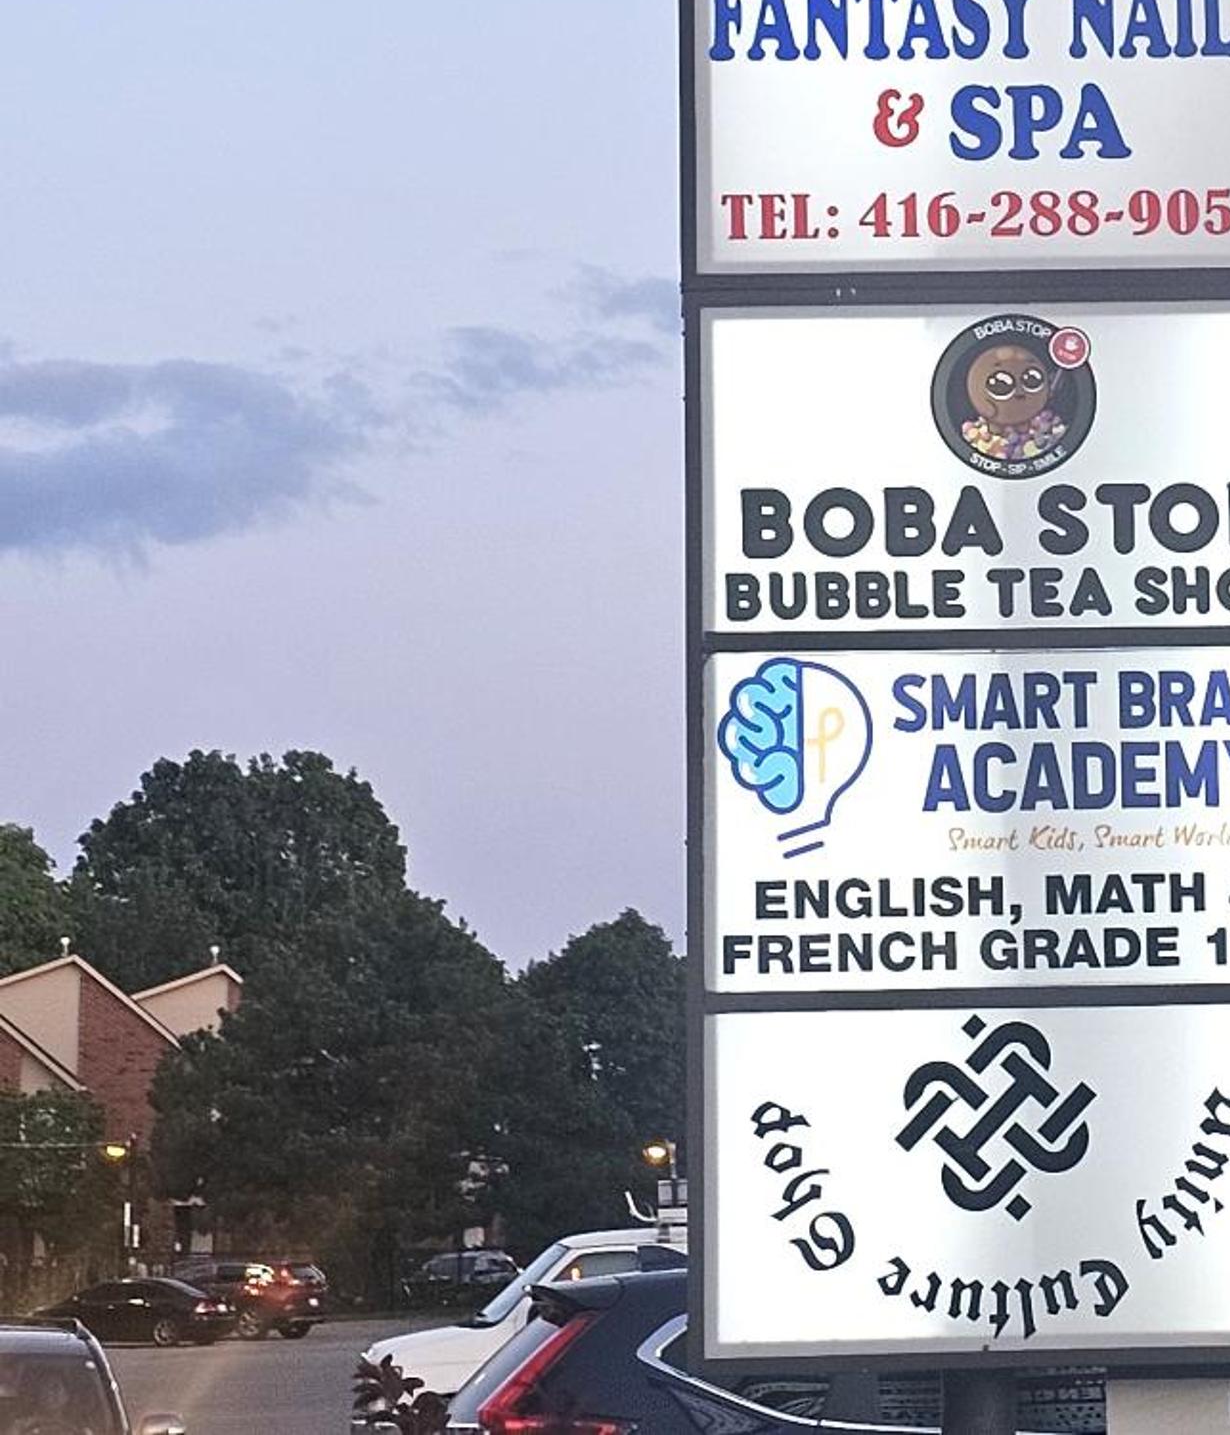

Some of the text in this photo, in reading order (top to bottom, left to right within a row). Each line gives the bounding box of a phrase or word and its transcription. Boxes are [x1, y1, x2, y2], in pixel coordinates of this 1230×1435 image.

[872, 82, 1132, 161] & SPA
[720, 193, 840, 240] TEL:
[973, 319, 1053, 340] BOBA STOP
[969, 452, 1002, 473] STOP
[740, 485, 1004, 559] BOBA
[725, 569, 967, 621] BUBBLE
[987, 567, 1113, 619] TEA
[891, 670, 1098, 733] SMART
[948, 826, 1020, 852] Smart
[1027, 824, 1086, 852] Kids,
[1093, 823, 1166, 849] Smart
[755, 875, 1023, 925] ENGLISH,
[1045, 872, 1207, 916] MATH
[721, 931, 957, 975] FRENCH
[979, 927, 1181, 970] GRADE
[750, 1100, 857, 1272] Shop
[877, 1256, 1129, 1340] Culture
